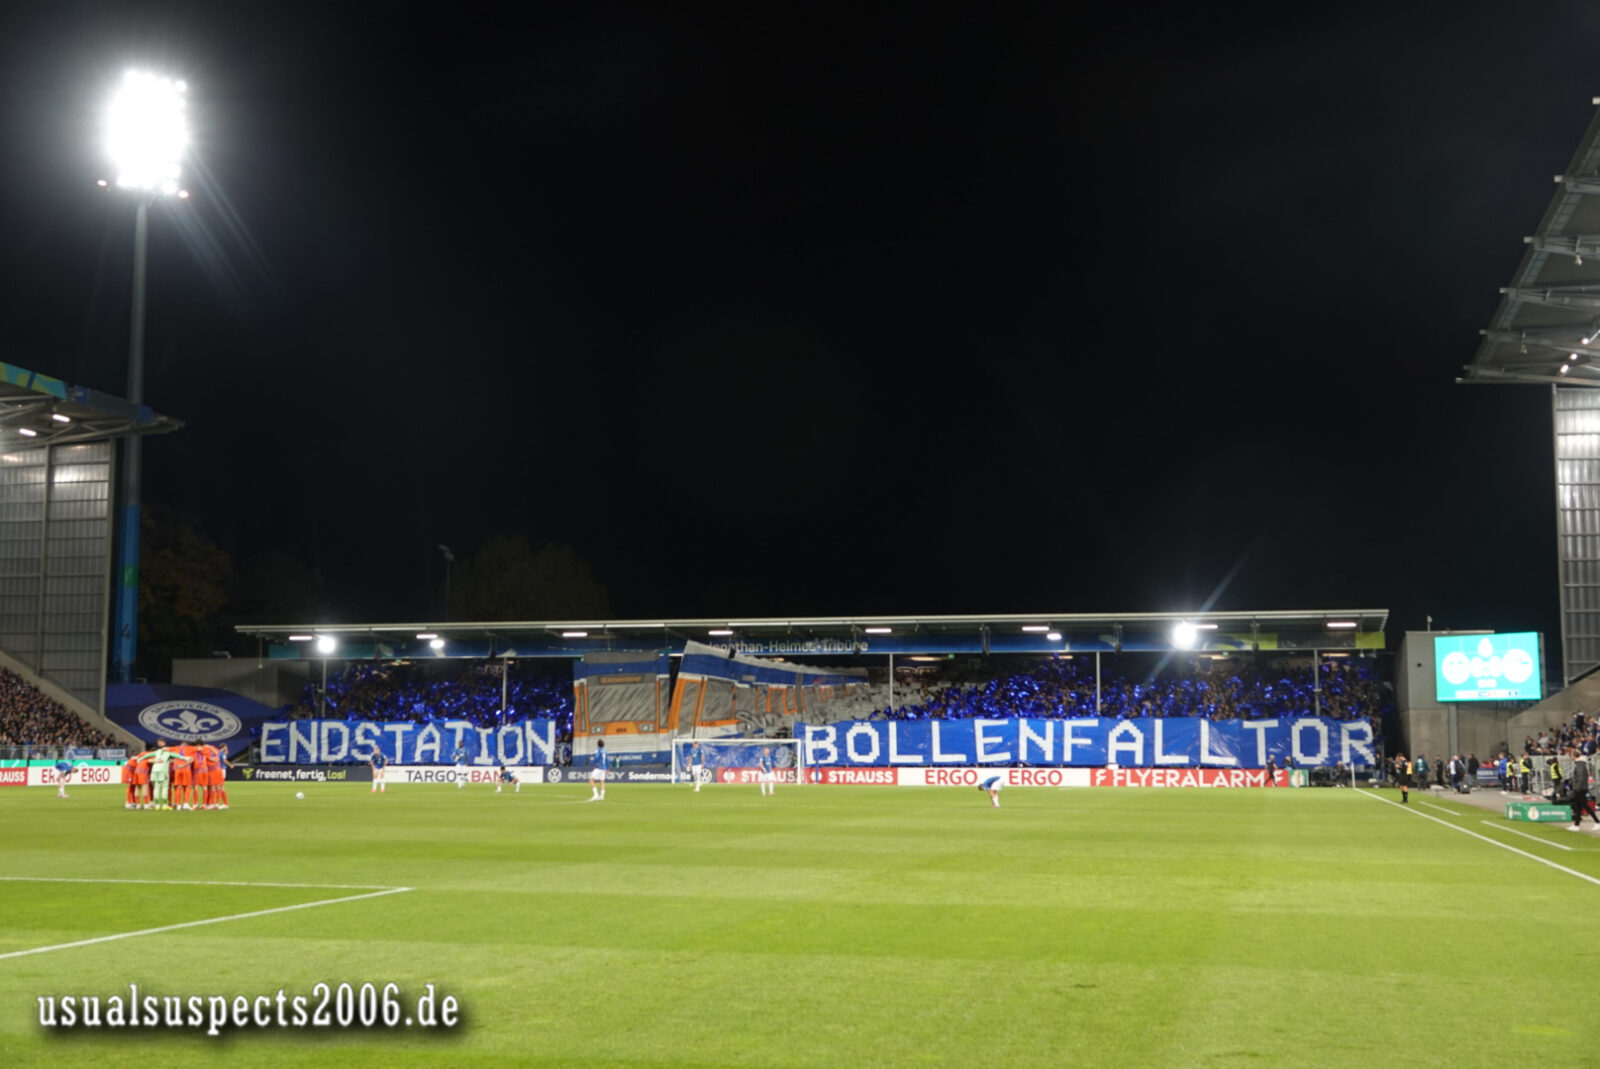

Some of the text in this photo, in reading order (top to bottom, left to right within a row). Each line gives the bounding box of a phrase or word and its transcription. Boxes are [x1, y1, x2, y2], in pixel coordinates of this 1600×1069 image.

[260, 719, 556, 766] ENDSTATION
[805, 717, 1376, 766] BÖLLENFALLTOR
[81, 767, 110, 782] ERGO
[255, 769, 346, 781] freenet, fertig, los!
[828, 770, 893, 783] STRAUSS
[925, 769, 978, 785] ERGO
[1008, 769, 1063, 785] ERGO
[1112, 769, 1265, 787] FLYERALARM
